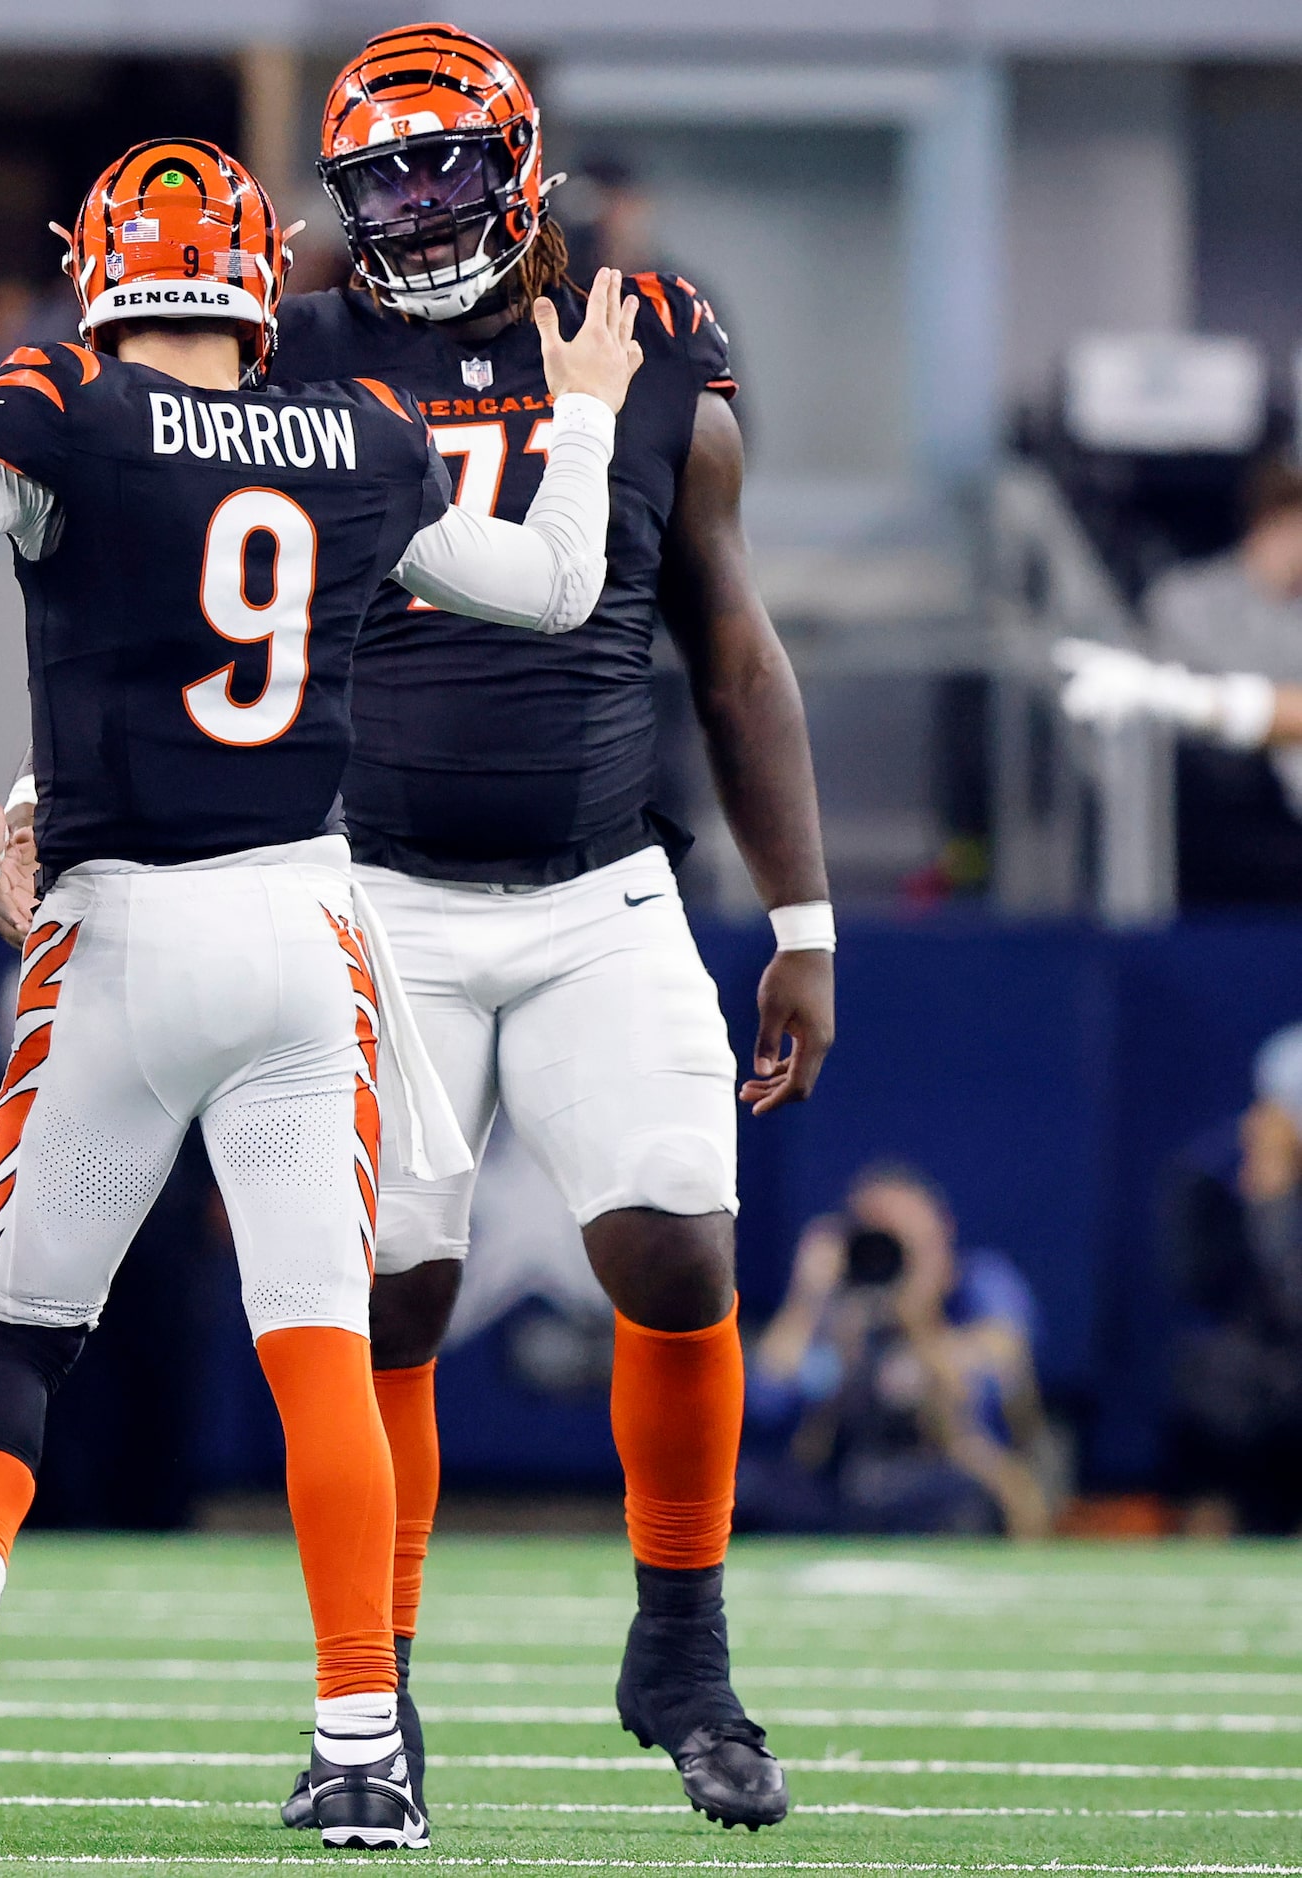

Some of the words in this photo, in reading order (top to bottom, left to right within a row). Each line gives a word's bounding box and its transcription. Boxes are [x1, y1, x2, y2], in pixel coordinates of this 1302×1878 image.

[182, 245, 199, 278] 9
[113, 291, 230, 307] BENGALS
[149, 392, 357, 470] BURROW
[182, 486, 318, 747] 9
